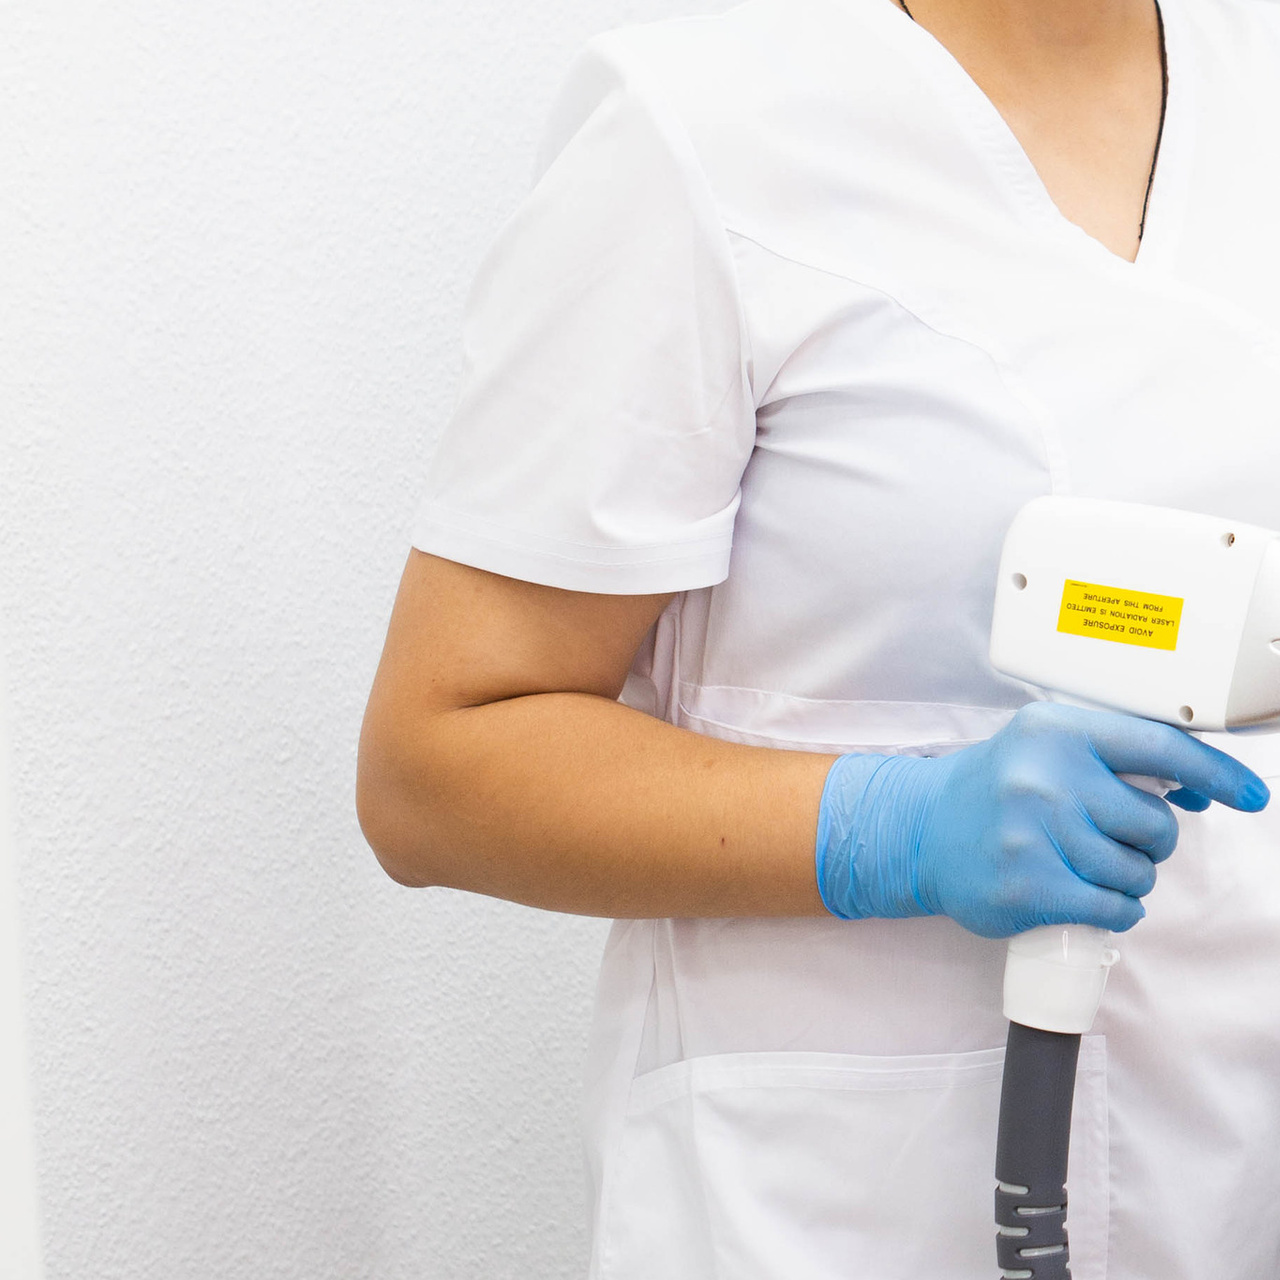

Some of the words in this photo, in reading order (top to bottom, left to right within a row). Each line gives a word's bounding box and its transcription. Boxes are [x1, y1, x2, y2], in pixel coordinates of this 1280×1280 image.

[1083, 592, 1121, 605] APERTURE
[1123, 599, 1140, 609] THIS
[1066, 602, 1097, 614] EMITTED
[1099, 608, 1107, 616] IS
[1142, 603, 1164, 613] FROM
[1109, 610, 1148, 623] RADIATION
[1150, 617, 1175, 627] LASER
[1083, 618, 1125, 633] EXPOSURE
[1128, 626, 1154, 637] AVOID
